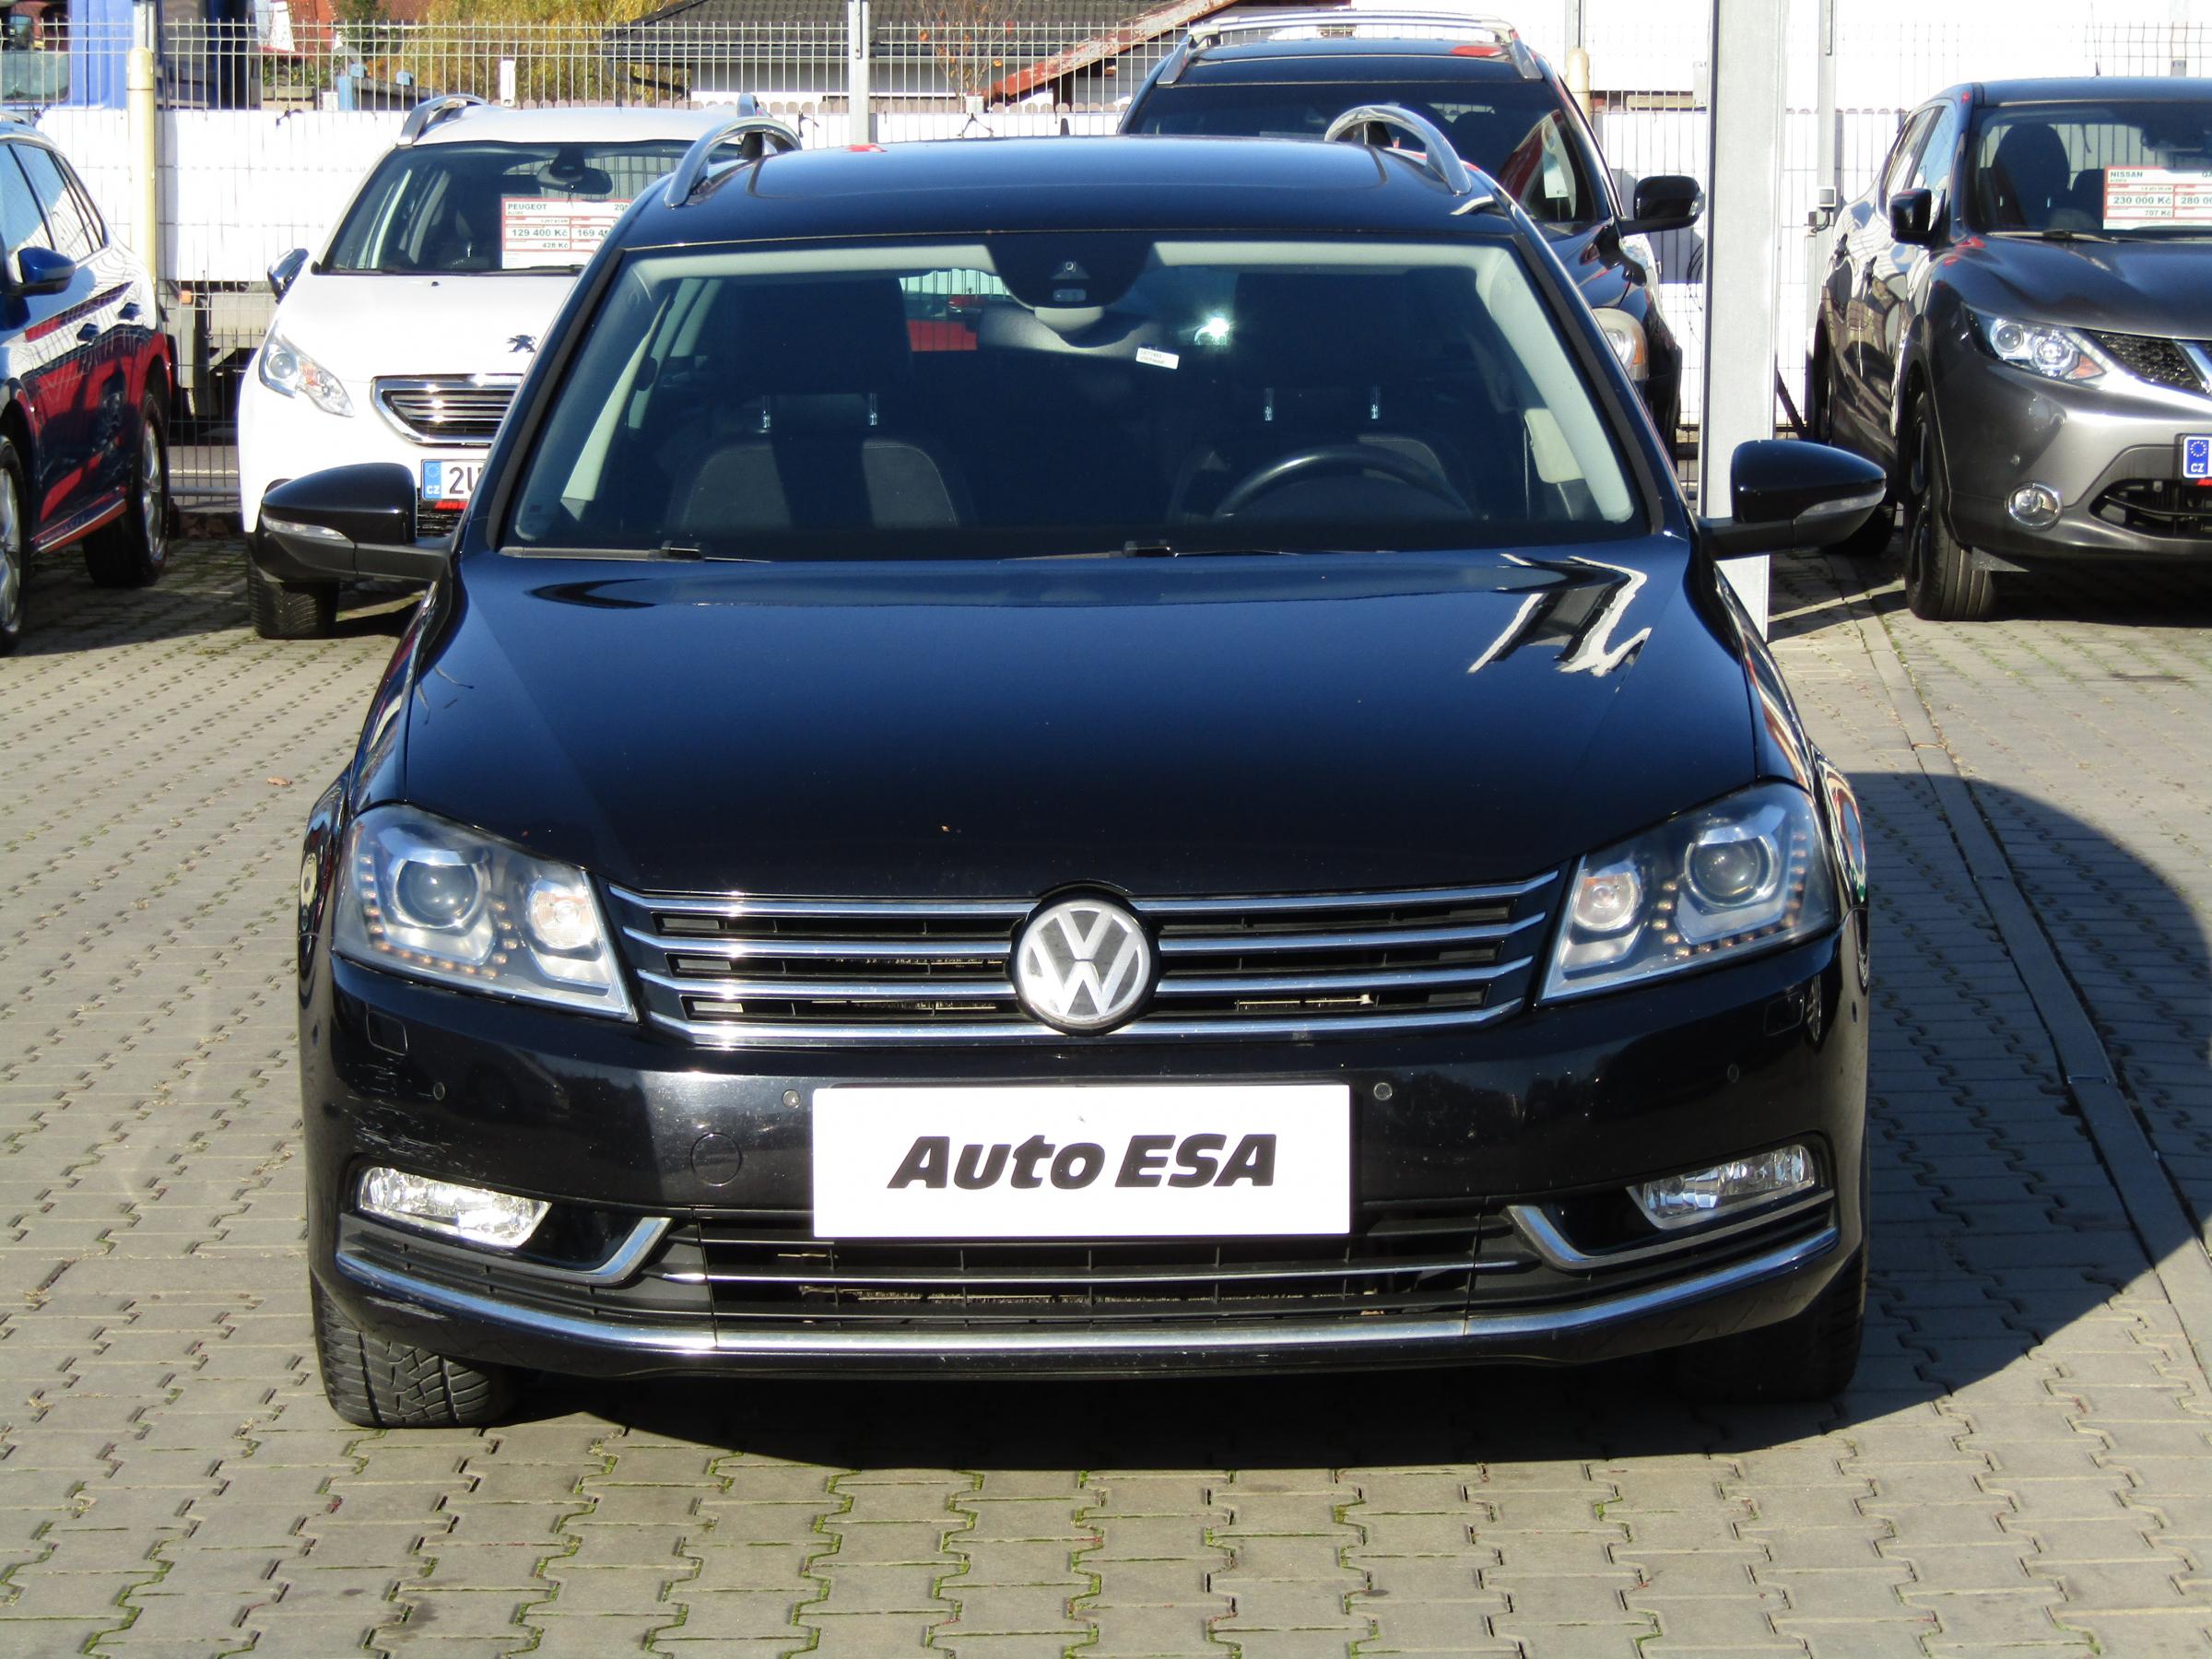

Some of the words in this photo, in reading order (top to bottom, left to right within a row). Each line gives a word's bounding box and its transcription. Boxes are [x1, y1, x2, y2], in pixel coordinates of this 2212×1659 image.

[2190, 463, 2205, 473] CZ
[427, 485, 441, 495] CZ
[887, 1135, 1106, 1190] Auto
[1115, 1133, 1277, 1188] ESA
